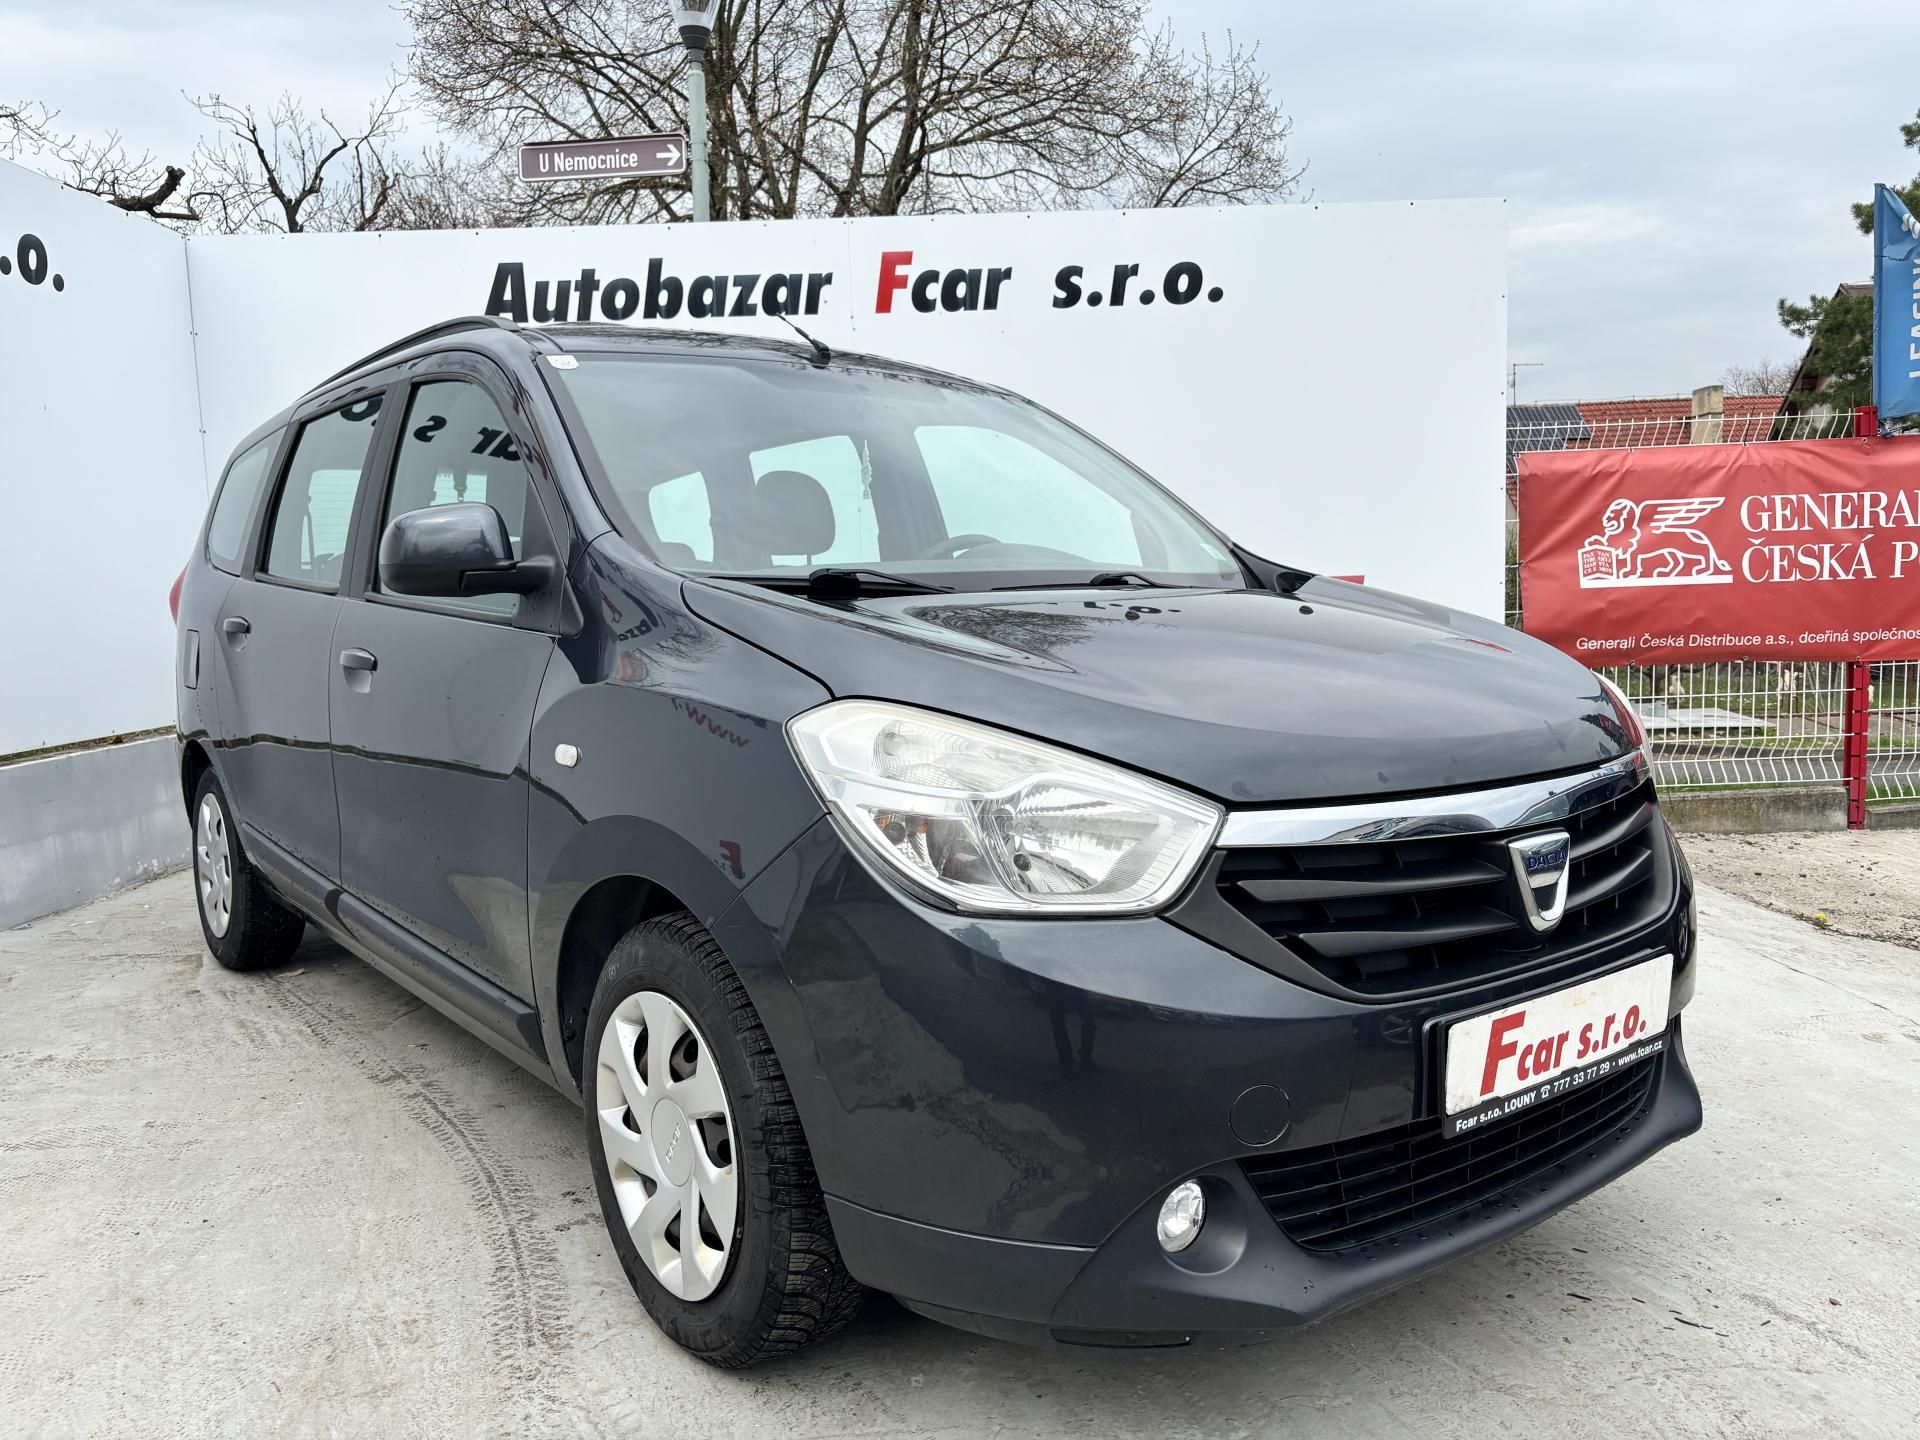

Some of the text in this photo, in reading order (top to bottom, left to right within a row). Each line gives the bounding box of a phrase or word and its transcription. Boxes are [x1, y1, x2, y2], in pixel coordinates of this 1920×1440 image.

[538, 148, 639, 173] U Nemocnice
[484, 250, 1224, 323] Autobazar Fcar s.r.o.
[1740, 489, 1920, 533] GENERA
[1741, 533, 1877, 583] ČESKÁ
[1576, 636, 1636, 650] Generali
[1639, 632, 1685, 648] Česká
[1688, 633, 1761, 647] Distribuce
[1765, 634, 1794, 646] a.s.,
[1799, 629, 1849, 644] dceřiná
[1528, 849, 1566, 870] DACIA
[1479, 1004, 1647, 1097] Fcar s.r.o.
[1456, 1040, 1663, 1132] Fcar s.r.o. LOUNY 777 33 77 29 www.fcar.cz
